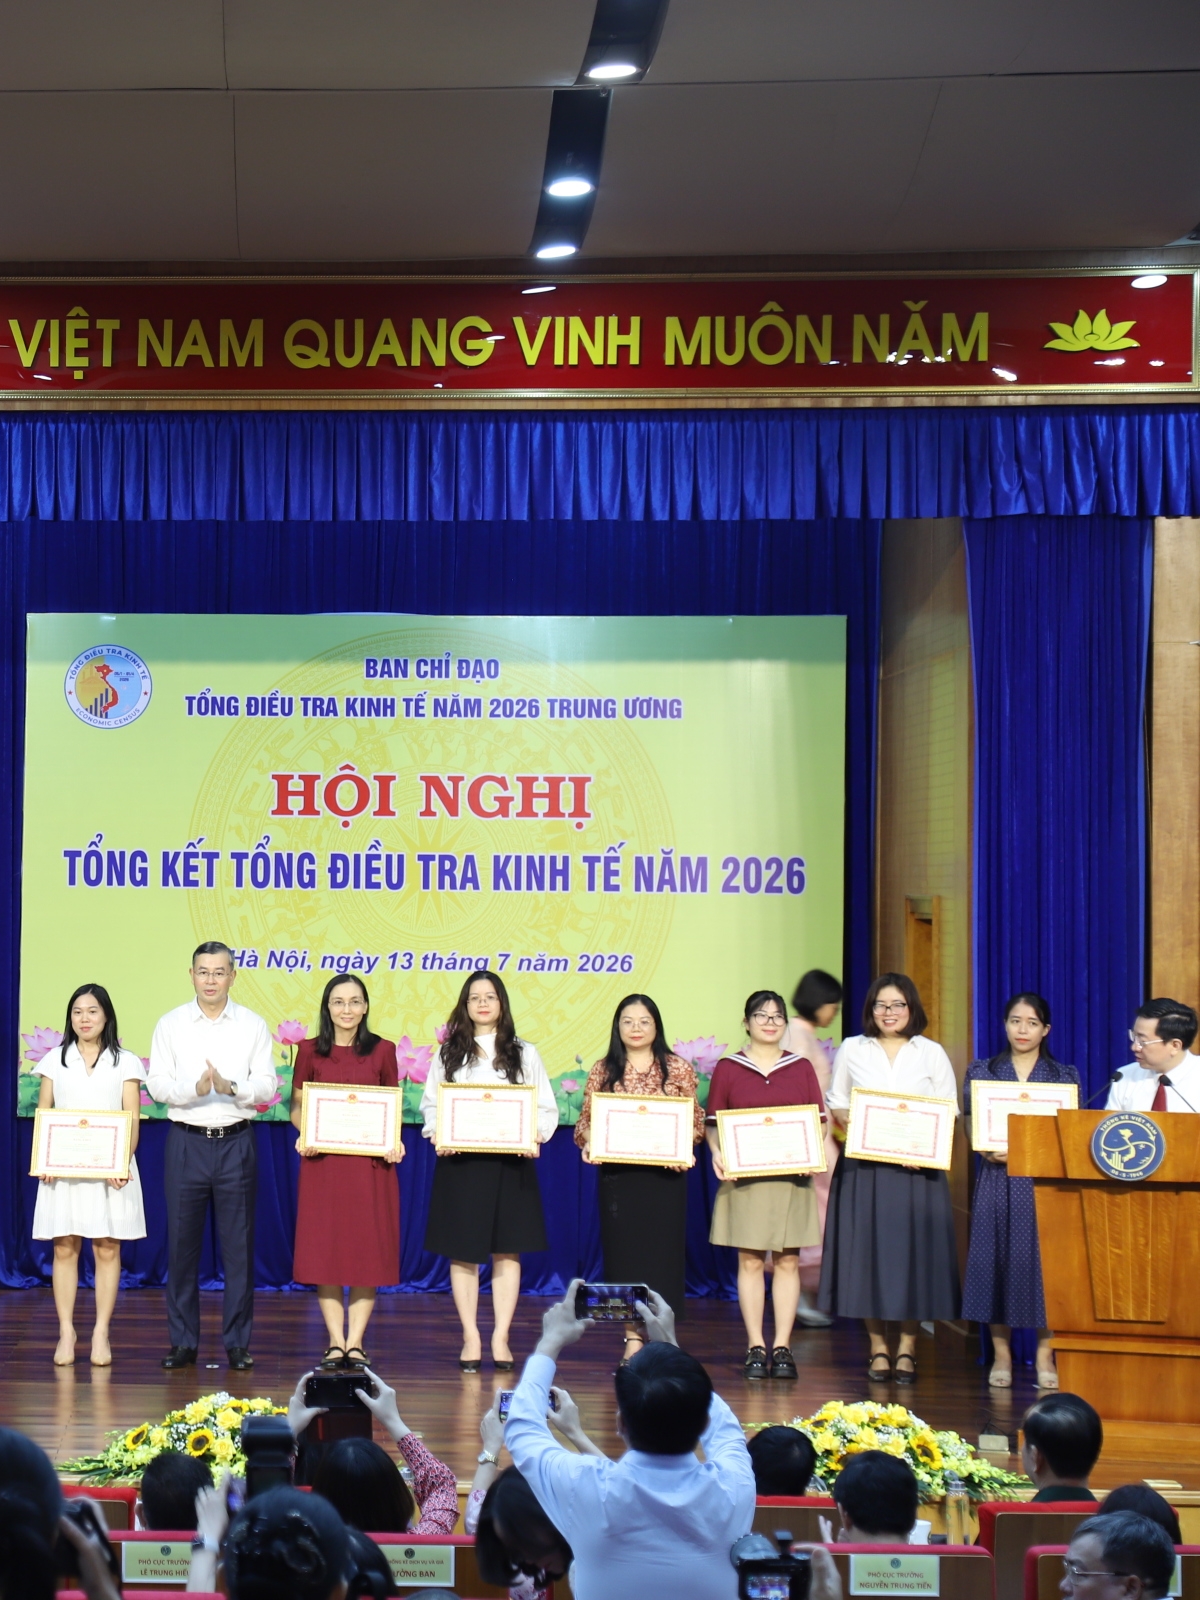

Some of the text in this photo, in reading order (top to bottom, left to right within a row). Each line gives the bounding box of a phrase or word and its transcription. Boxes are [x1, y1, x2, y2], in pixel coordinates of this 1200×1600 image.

[9, 306, 120, 380] VIỆT
[138, 318, 263, 368] NAM
[284, 316, 494, 368] QUANG
[512, 316, 641, 366] VINH
[665, 303, 832, 366] MUÔN
[852, 301, 989, 363] NĂM
[106, 648, 122, 656] TRA
[125, 653, 142, 669] KINH
[364, 652, 501, 684] BAN CHỈ ĐẠO
[185, 688, 683, 720] TỔNG ĐIỀU TRA KINH TẾ NĂM 2026 TRUNG ƯƠNG
[76, 708, 141, 726] ECONOMIC CENSUS
[272, 763, 592, 831] HỘI NGHỊ
[63, 833, 806, 895] TỔNG KẾT TỔNG ĐIỀU TRA KINH TẾ NĂM 2026
[232, 949, 634, 975] Hà Nội, ngày 13 tháng 7 năm 2026
[1145, 1123, 1158, 1135] NAM
[140, 1568, 147, 1576] LÊ
[420, 1570, 436, 1578] BAN
[917, 1581, 932, 1589] TIẾN
